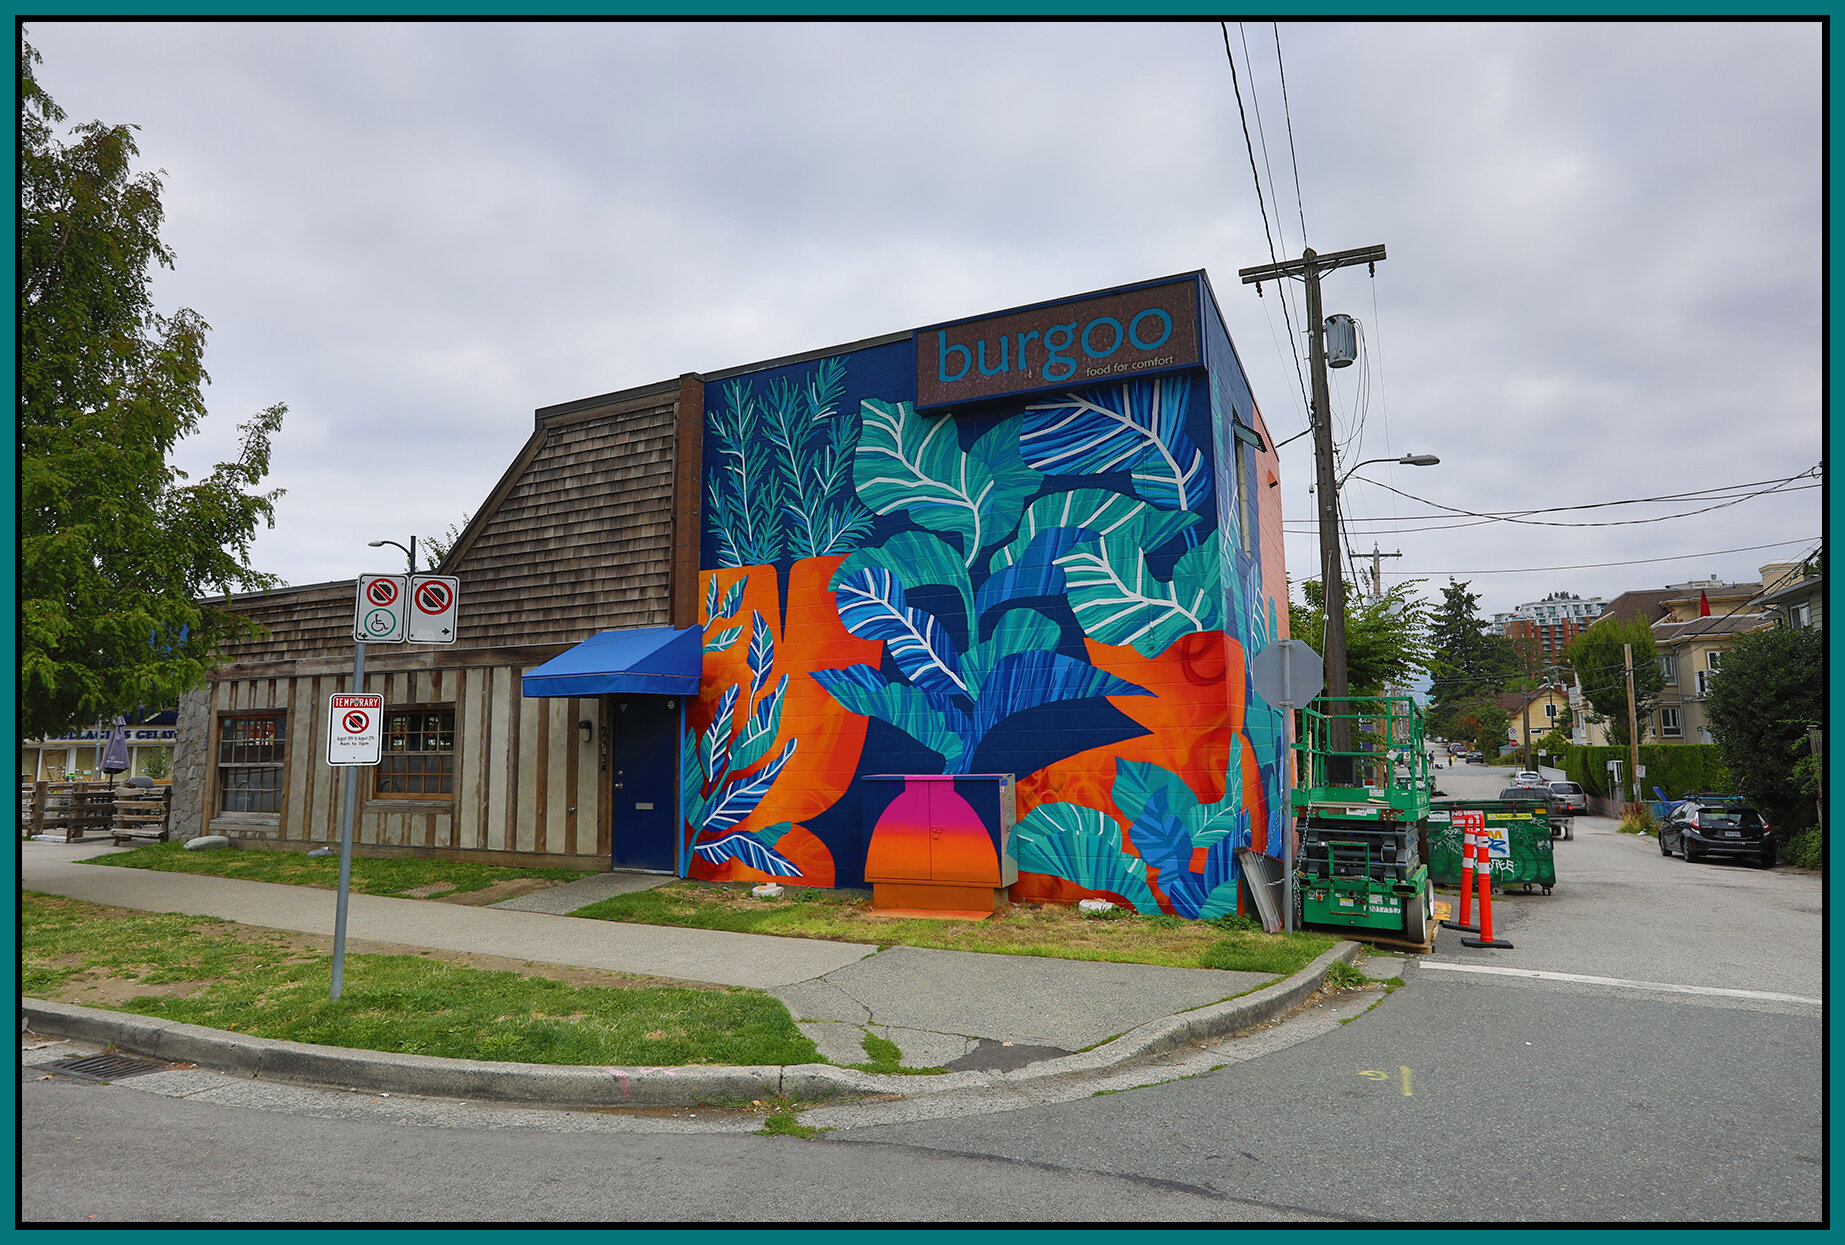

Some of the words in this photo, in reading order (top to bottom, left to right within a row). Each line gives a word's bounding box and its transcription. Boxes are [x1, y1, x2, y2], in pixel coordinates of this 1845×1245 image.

[937, 307, 1173, 382] burgoo
[1086, 364, 1111, 377] food
[1113, 362, 1129, 372] for
[1131, 355, 1174, 370] comfort
